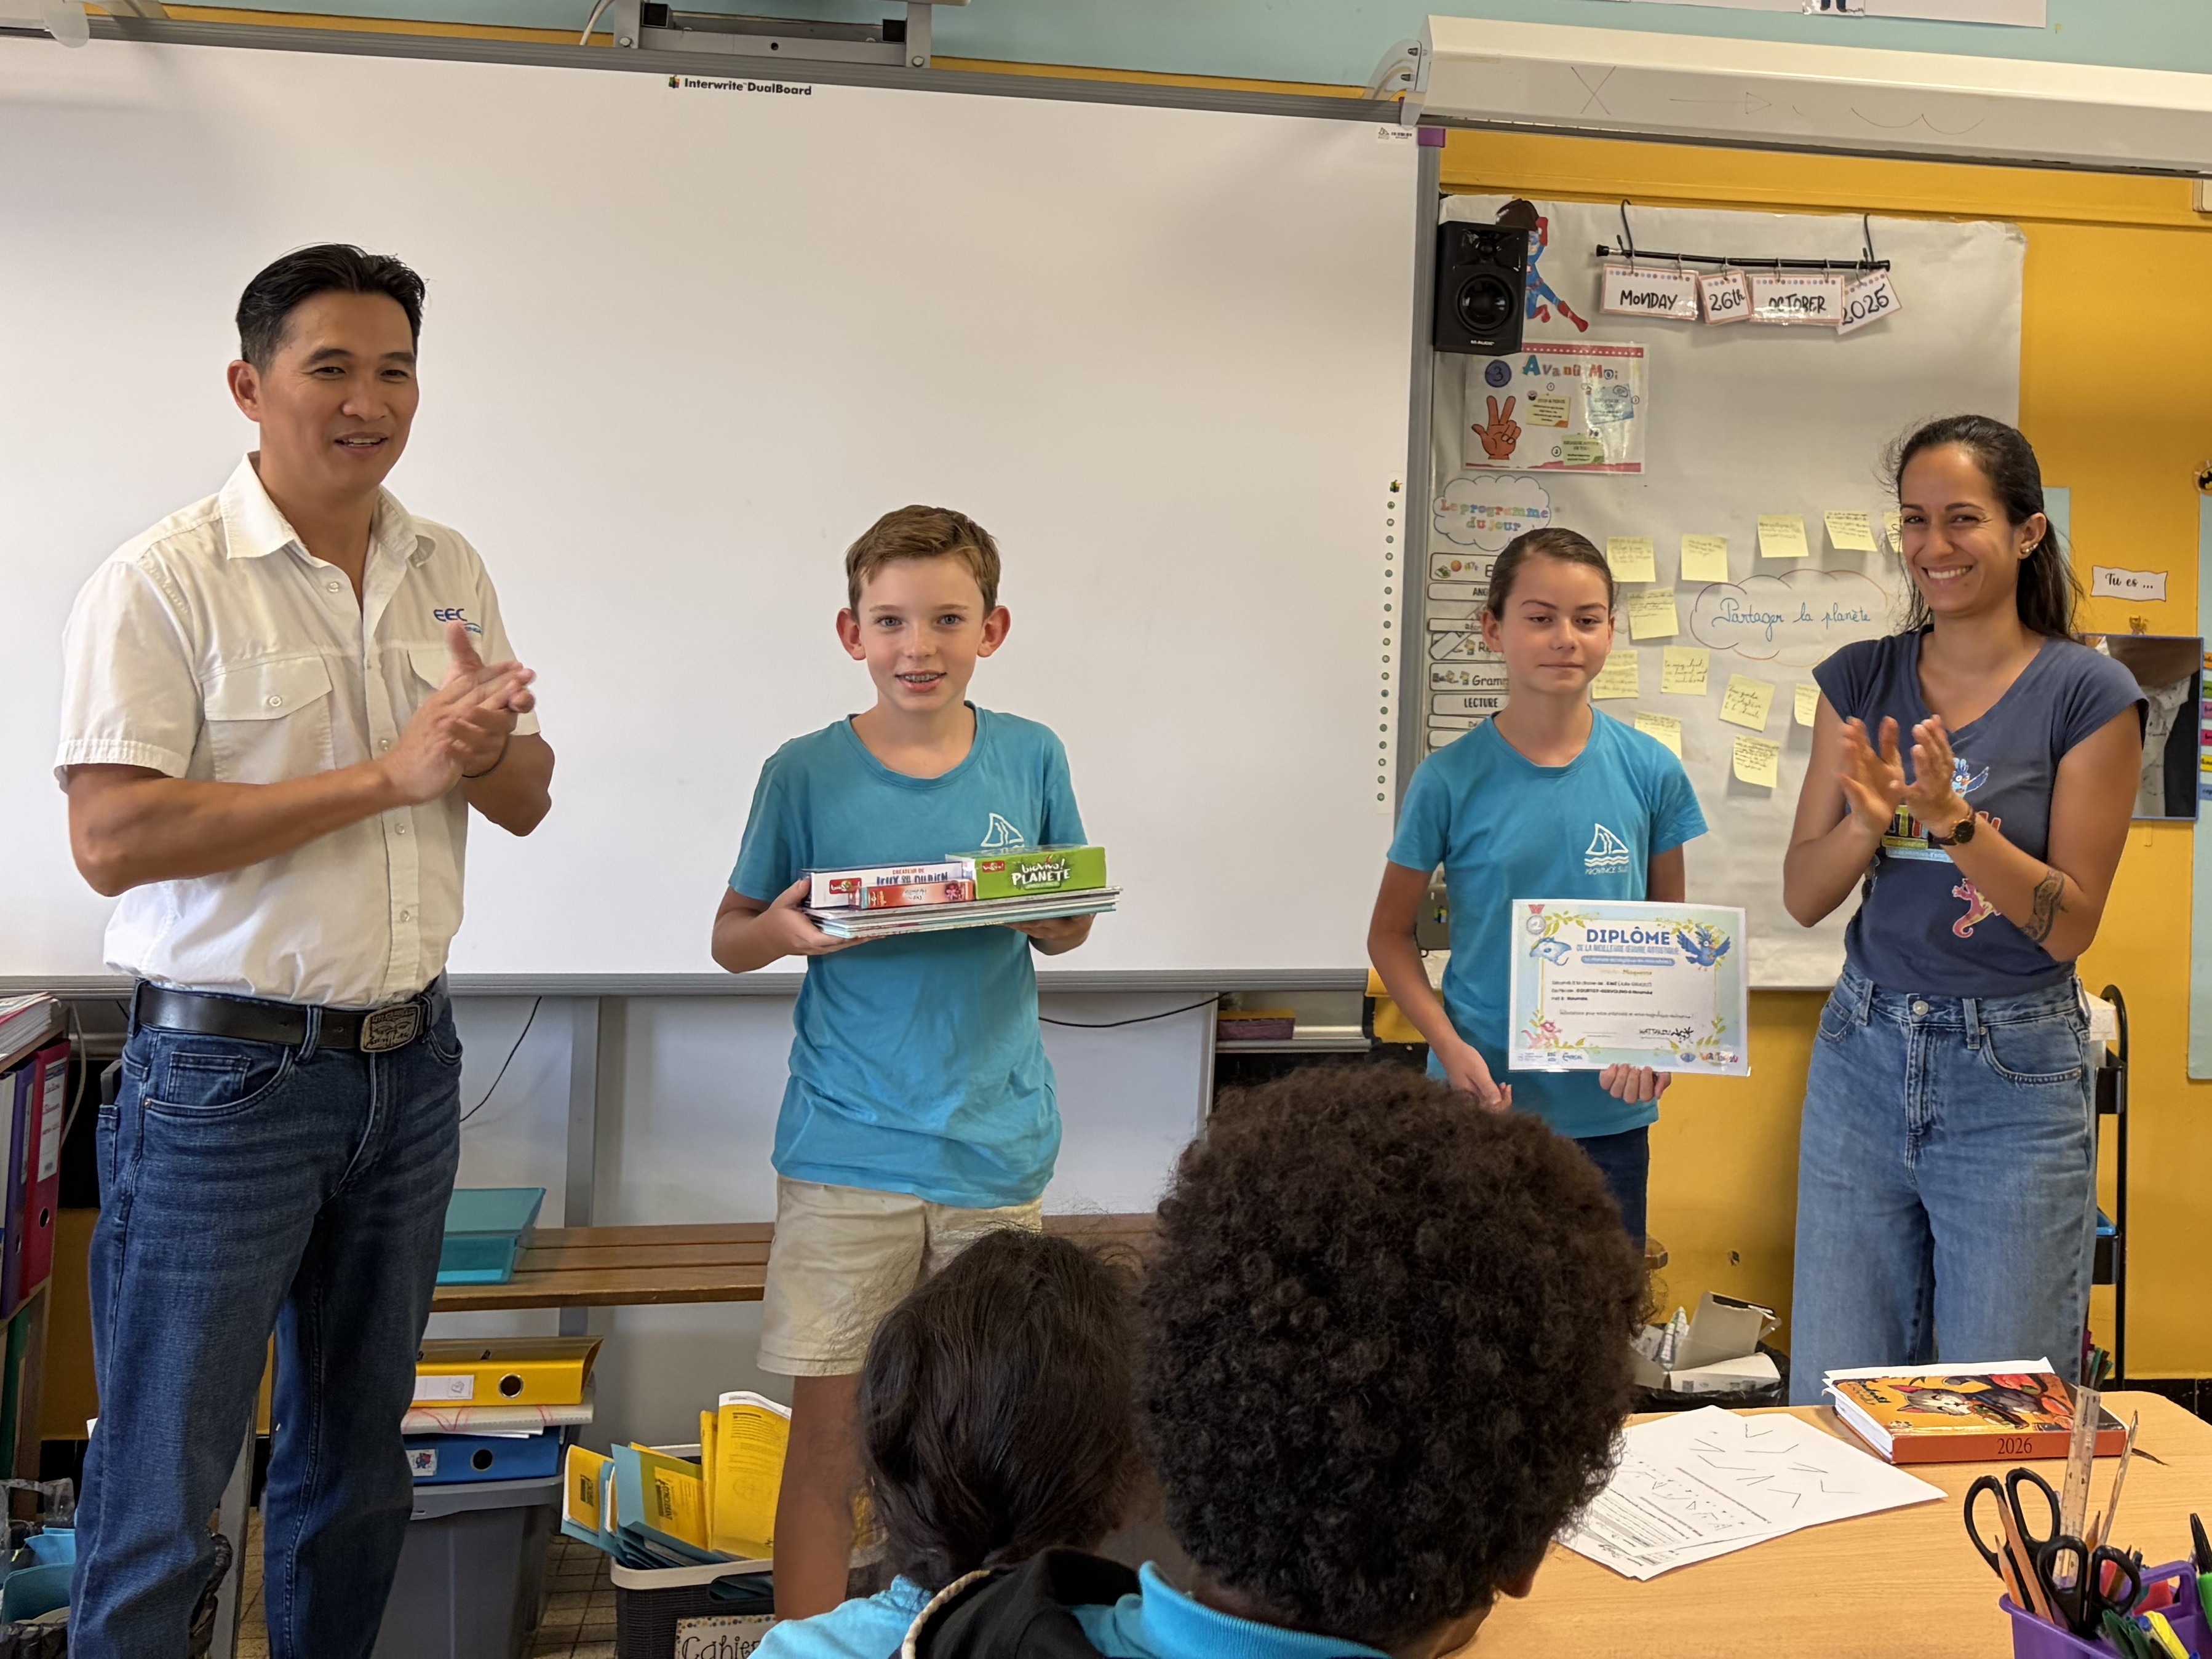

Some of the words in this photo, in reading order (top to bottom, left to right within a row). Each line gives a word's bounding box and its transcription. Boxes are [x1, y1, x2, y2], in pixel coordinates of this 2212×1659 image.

[685, 78, 744, 92] Interwrite
[747, 82, 812, 95] DualBoard
[1708, 288, 1746, 311] 26th
[1768, 293, 1826, 314] OCTOBER
[1441, 499, 1458, 512] Le
[1460, 504, 1549, 519] programme
[1466, 516, 1486, 529] du
[1488, 519, 1521, 532] jour
[2105, 573, 2122, 586] Tu
[2126, 578, 2138, 587] es
[433, 608, 467, 622] EEC
[1712, 598, 1784, 642] Partager
[1792, 602, 1813, 623] la
[1823, 602, 1871, 629] planète
[1464, 698, 1498, 708] LECTURE
[1586, 926, 1670, 945] DIPLÔME
[1997, 1437, 2033, 1454] 2026
